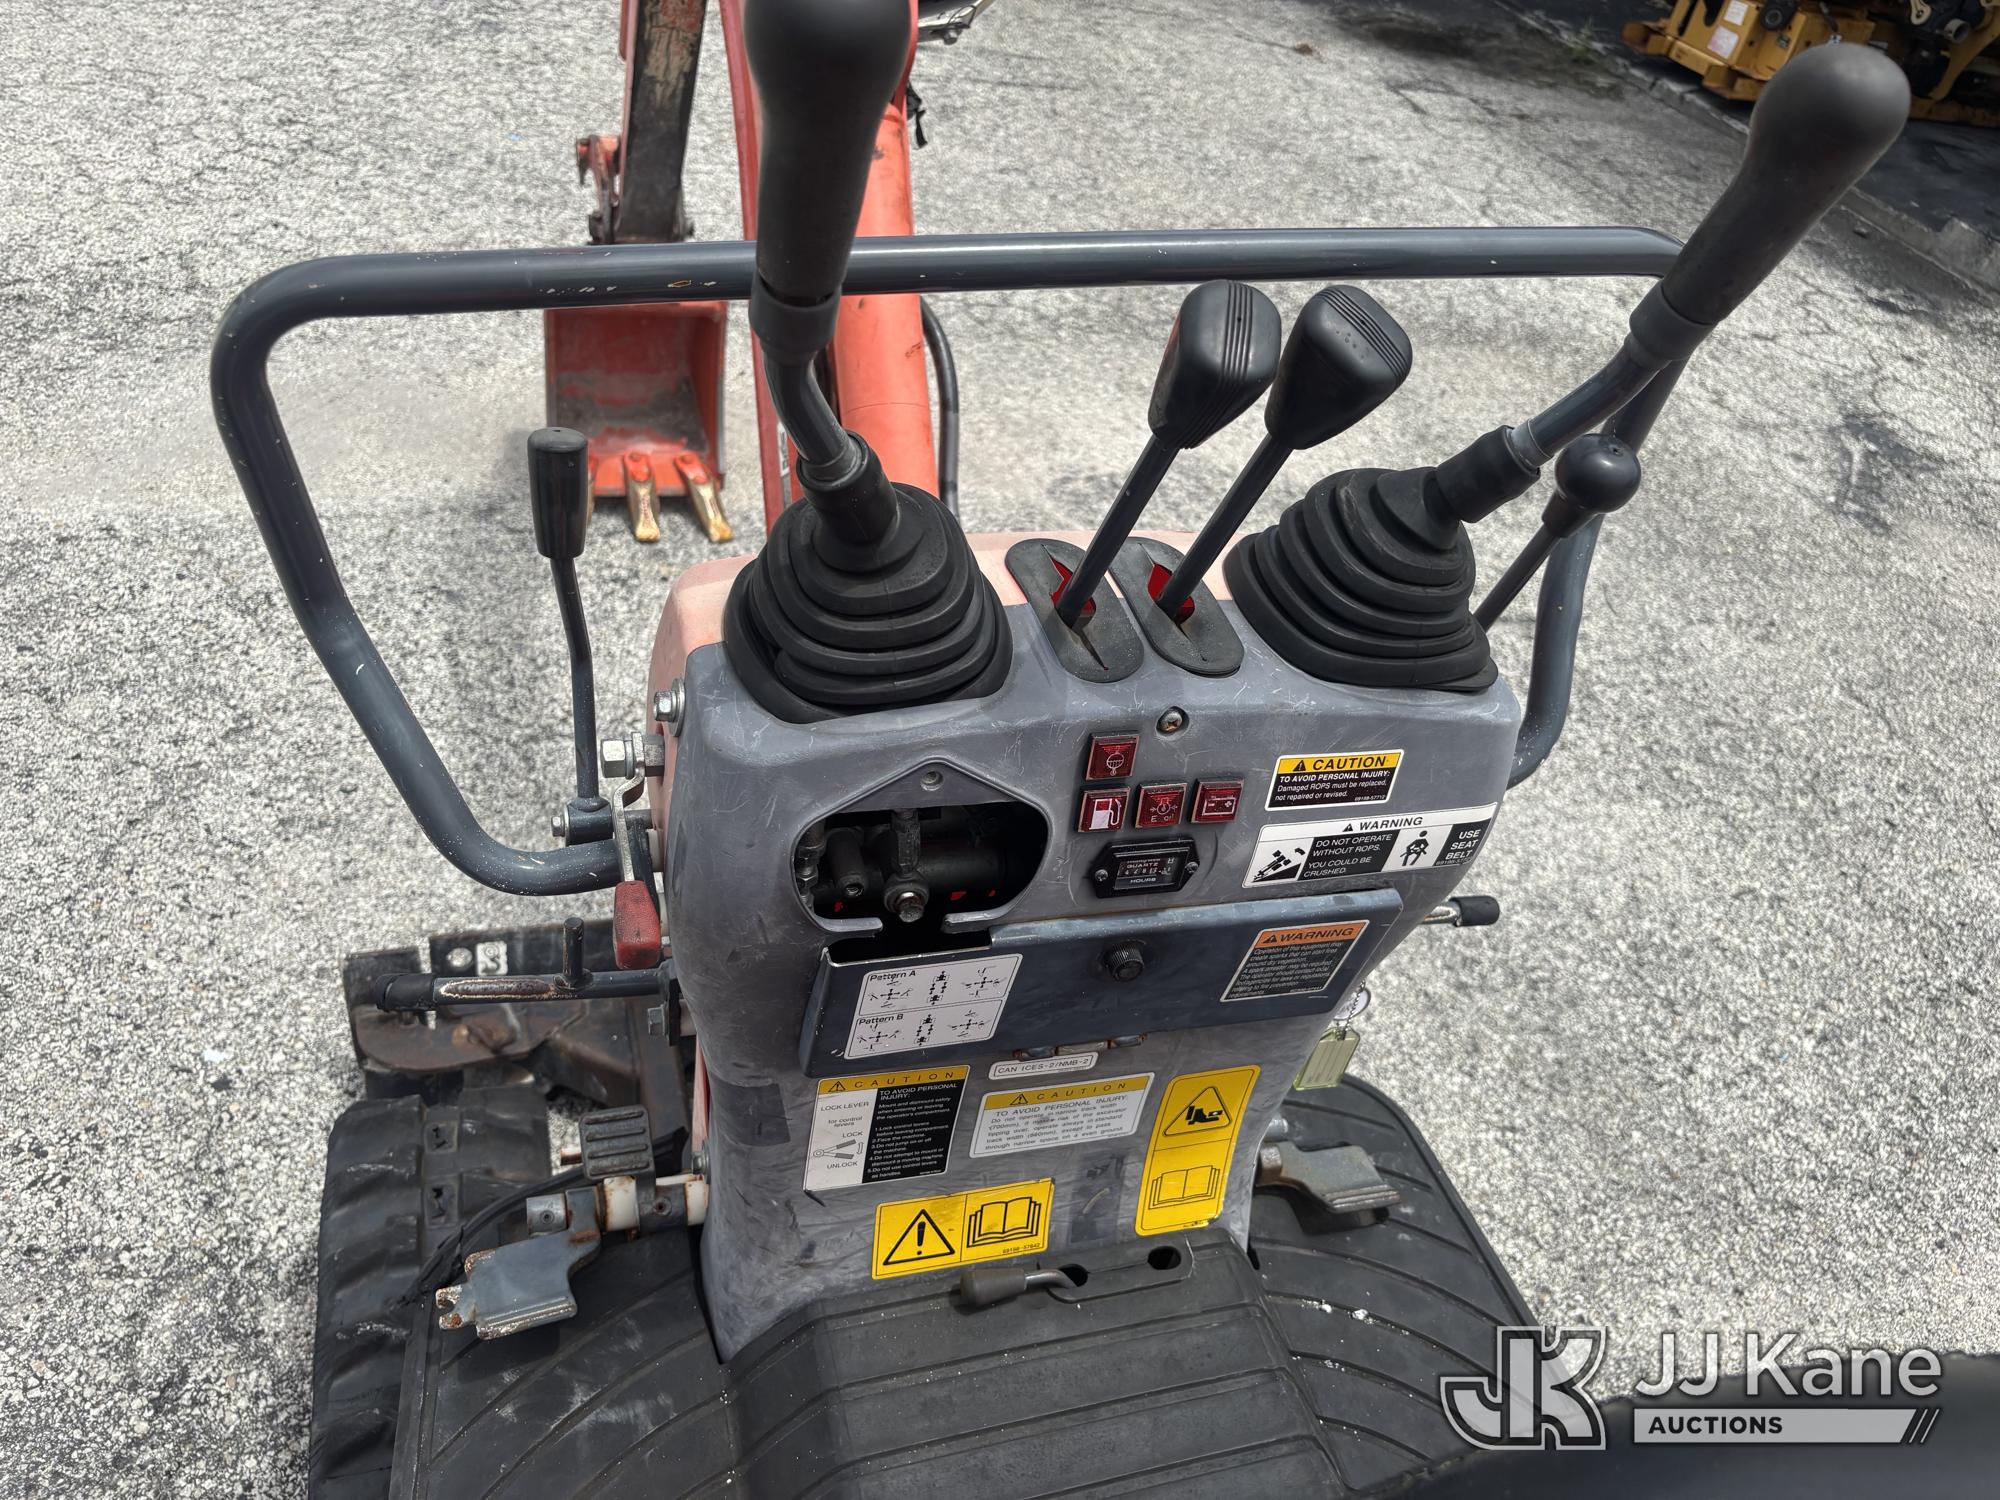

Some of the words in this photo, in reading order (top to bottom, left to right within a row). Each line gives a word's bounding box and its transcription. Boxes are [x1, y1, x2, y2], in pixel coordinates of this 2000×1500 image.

[1313, 756, 1386, 770] CAUTION
[1292, 774, 1316, 782] AVOID
[1316, 772, 1358, 781] PERSONAL
[1361, 770, 1390, 778] INJURY:
[1277, 784, 1308, 793] Damaged
[1287, 793, 1314, 801] repaired
[1360, 817, 1423, 831] WARNING
[1459, 829, 1481, 839] USE
[1315, 840, 1330, 848] DO
[1331, 838, 1350, 846] NOT
[1351, 834, 1393, 844] OPERATE
[1450, 839, 1478, 850] SEAT
[1313, 847, 1355, 856] WITHOUT
[1445, 850, 1473, 860] BELT
[1308, 861, 1326, 869] YOU
[1327, 858, 1359, 867] COULD
[1280, 928, 1354, 942] WARNING
[870, 972, 907, 981] Pattern
[858, 1015, 894, 1024] Pattern
[1021, 1059, 1089, 1072] ICES-2/NMB-2
[854, 1072, 953, 1088] CAUTION
[917, 1083, 958, 1092] PERSONAL
[1037, 1083, 1126, 1100] CAUTION
[843, 1101, 870, 1109] LEVER
[1012, 1106, 1040, 1114] AVOID
[1044, 1100, 1091, 1110] PERSONAL
[827, 1161, 858, 1169] UNLOCK
